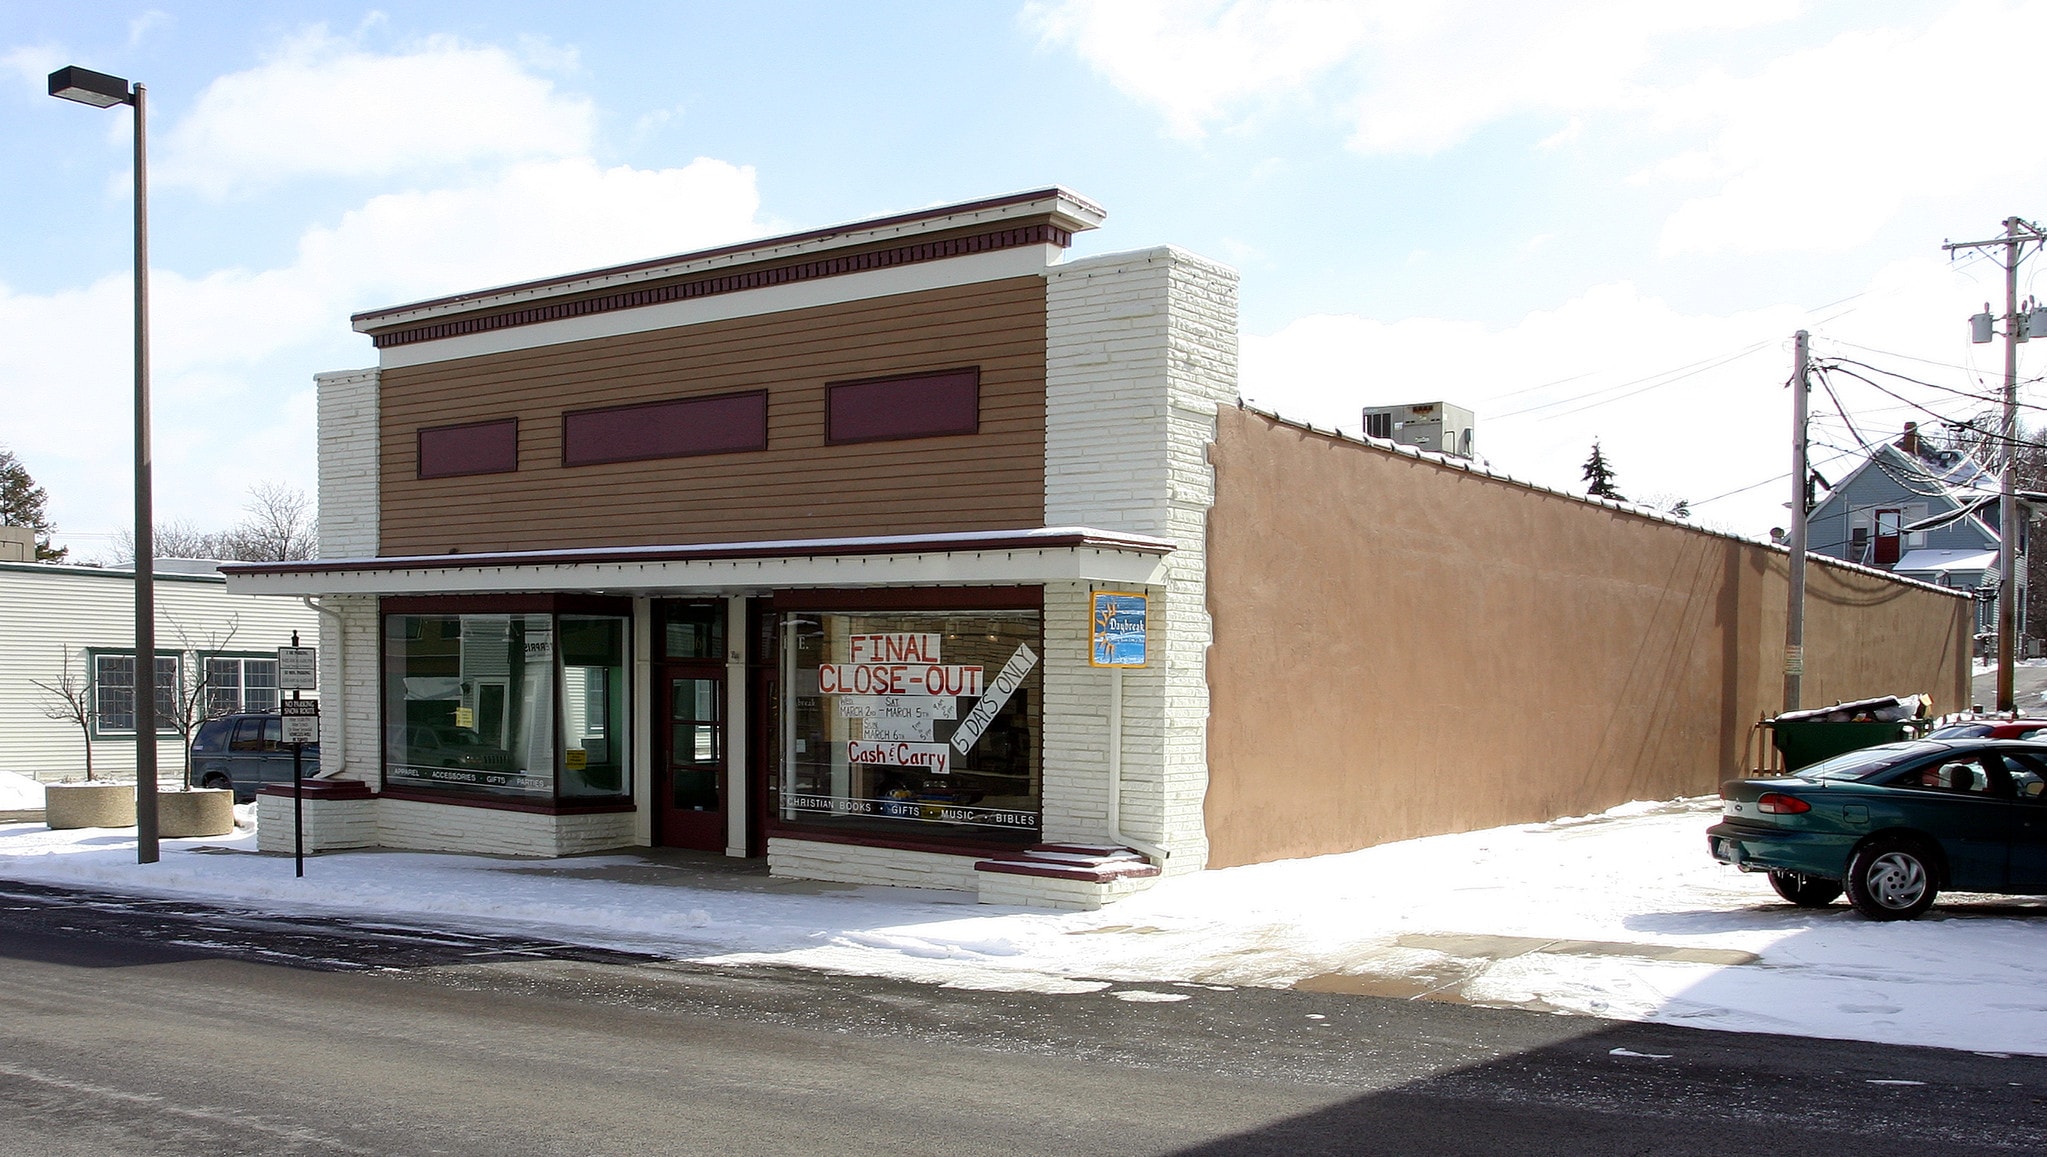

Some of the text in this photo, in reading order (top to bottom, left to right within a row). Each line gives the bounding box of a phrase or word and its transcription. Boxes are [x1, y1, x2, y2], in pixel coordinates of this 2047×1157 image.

[1110, 618, 1145, 635] Daybreak
[850, 634, 938, 663] FINAL
[819, 664, 983, 695] CLOSE-OUT
[840, 707, 863, 717] MARCH
[886, 707, 912, 718] MARCH
[952, 646, 1033, 752] 5 DAYS ONLY
[864, 730, 890, 740] MARCH
[848, 741, 886, 764] Cash
[897, 743, 946, 772] Carry
[394, 767, 544, 787] APPAREL ACCESSORIES GIFTS PARTIES
[787, 796, 1035, 825] CHRISTIAN BOOKS GIFTS MUSIC BIBLES
